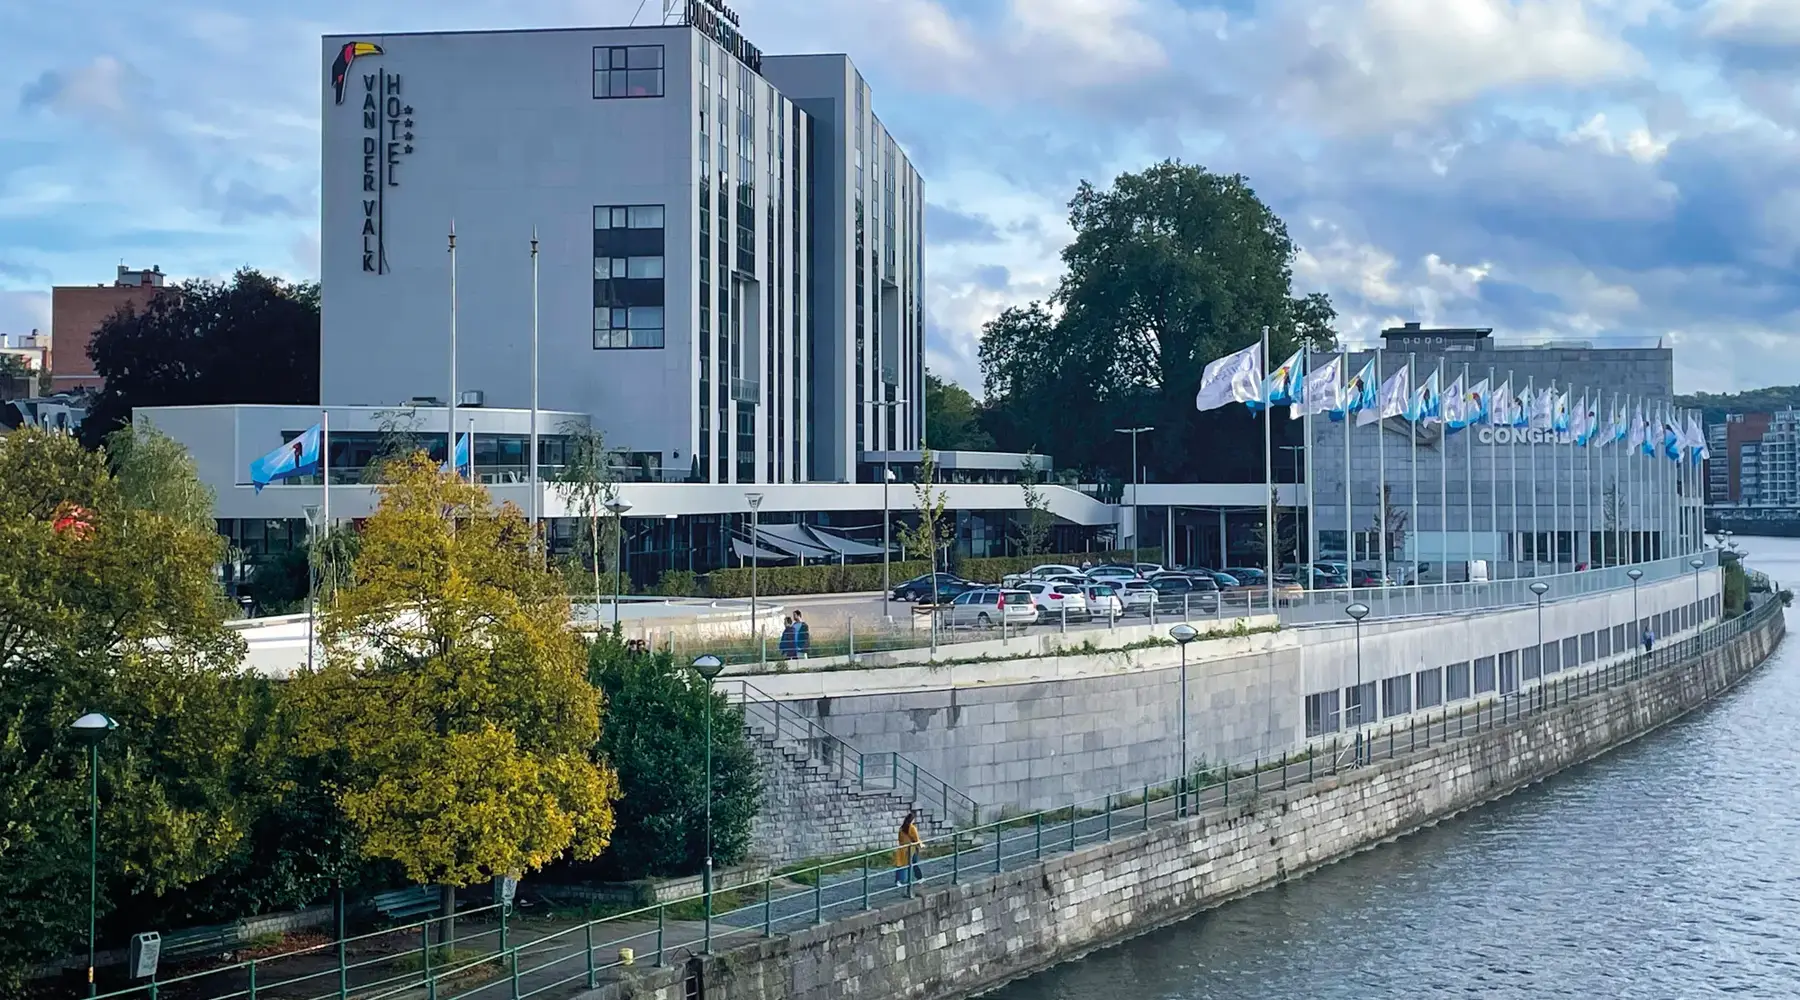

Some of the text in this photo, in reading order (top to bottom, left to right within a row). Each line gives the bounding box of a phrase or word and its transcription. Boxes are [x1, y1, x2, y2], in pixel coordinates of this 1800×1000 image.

[361, 74, 377, 271] VAN DER VALK
[386, 73, 401, 187] HOTEL
